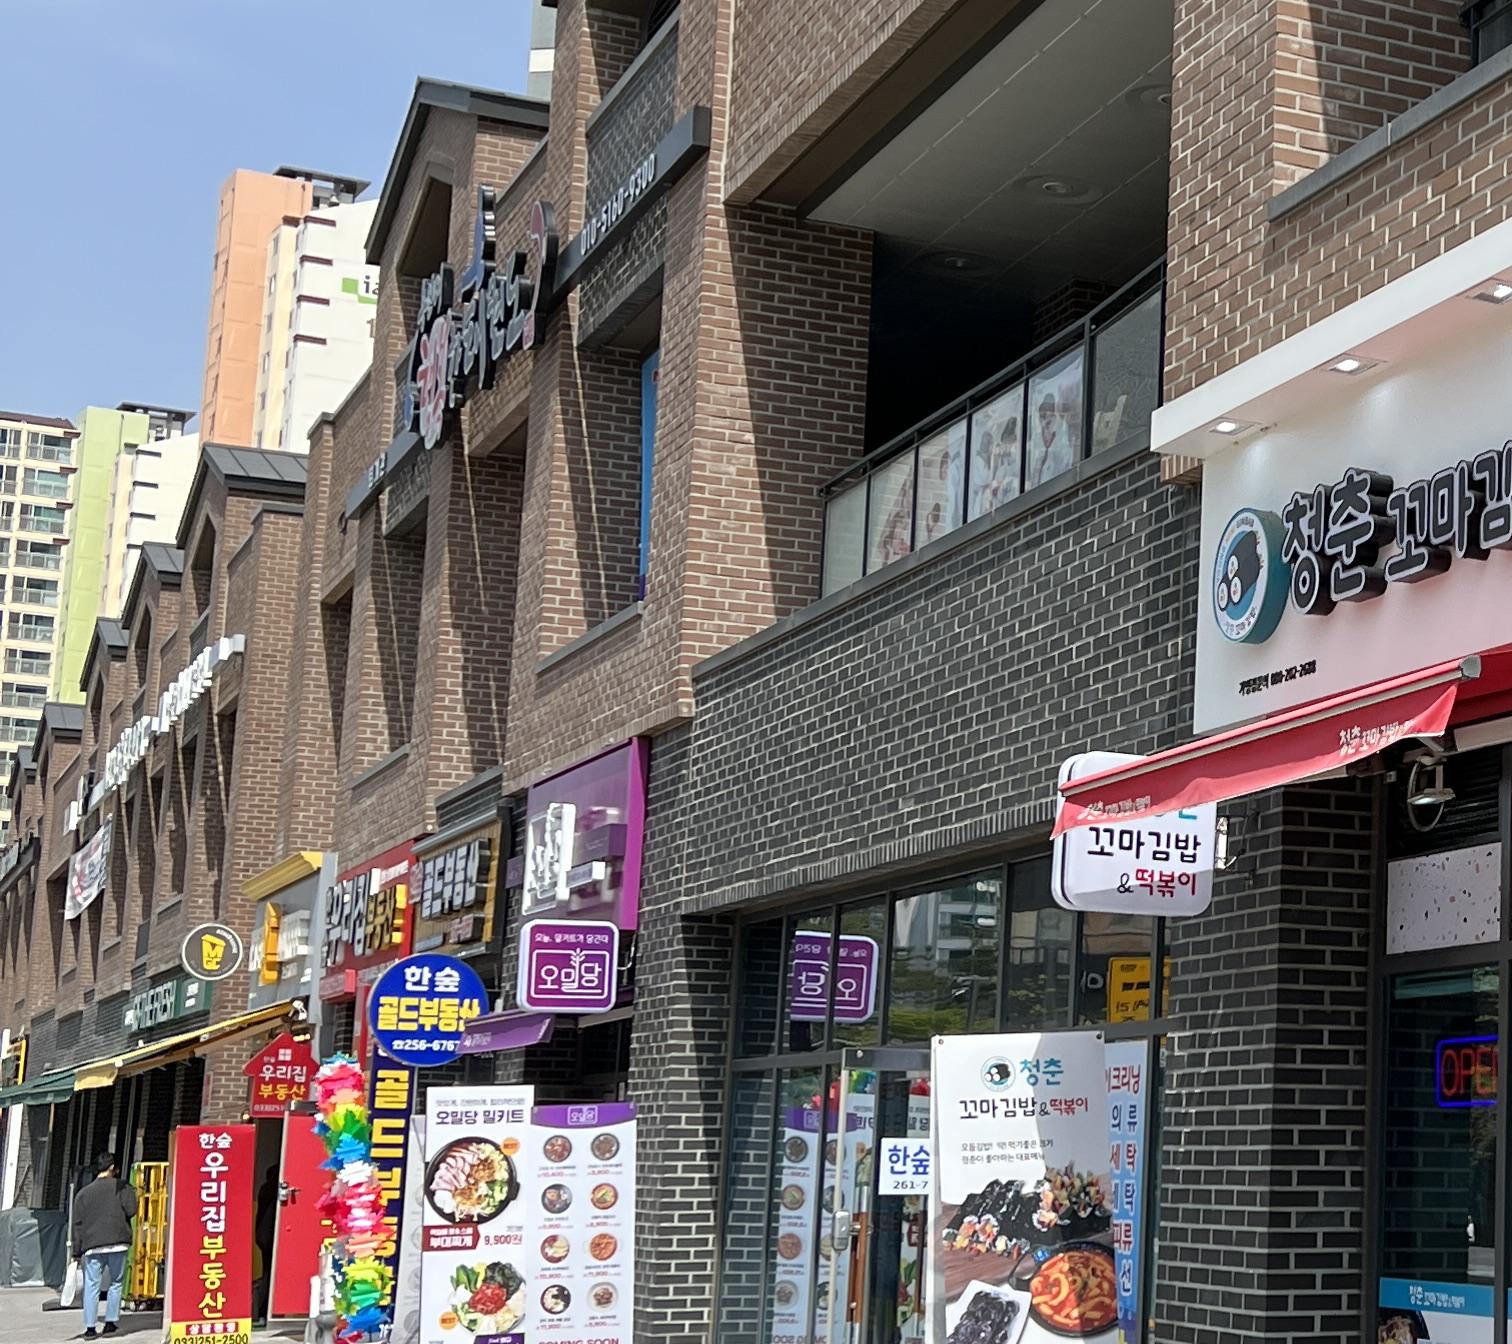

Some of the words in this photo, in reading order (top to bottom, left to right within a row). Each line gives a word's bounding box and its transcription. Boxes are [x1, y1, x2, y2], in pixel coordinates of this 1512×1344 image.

[1282, 469, 1376, 613] 청춘
[1087, 826, 1202, 864] 꼬마김밥
[404, 966, 460, 992] 한숲
[538, 949, 602, 993] 오밀당
[259, 1065, 307, 1083] 우리집
[1019, 1058, 1064, 1087] 청춘
[1442, 1046, 1499, 1097] OPE
[258, 1084, 306, 1101] 부동산
[436, 1110, 478, 1125] 오밀당
[483, 1109, 525, 1124] 밀키트
[199, 1132, 232, 1149] 한숲
[888, 1144, 930, 1175] 한숲
